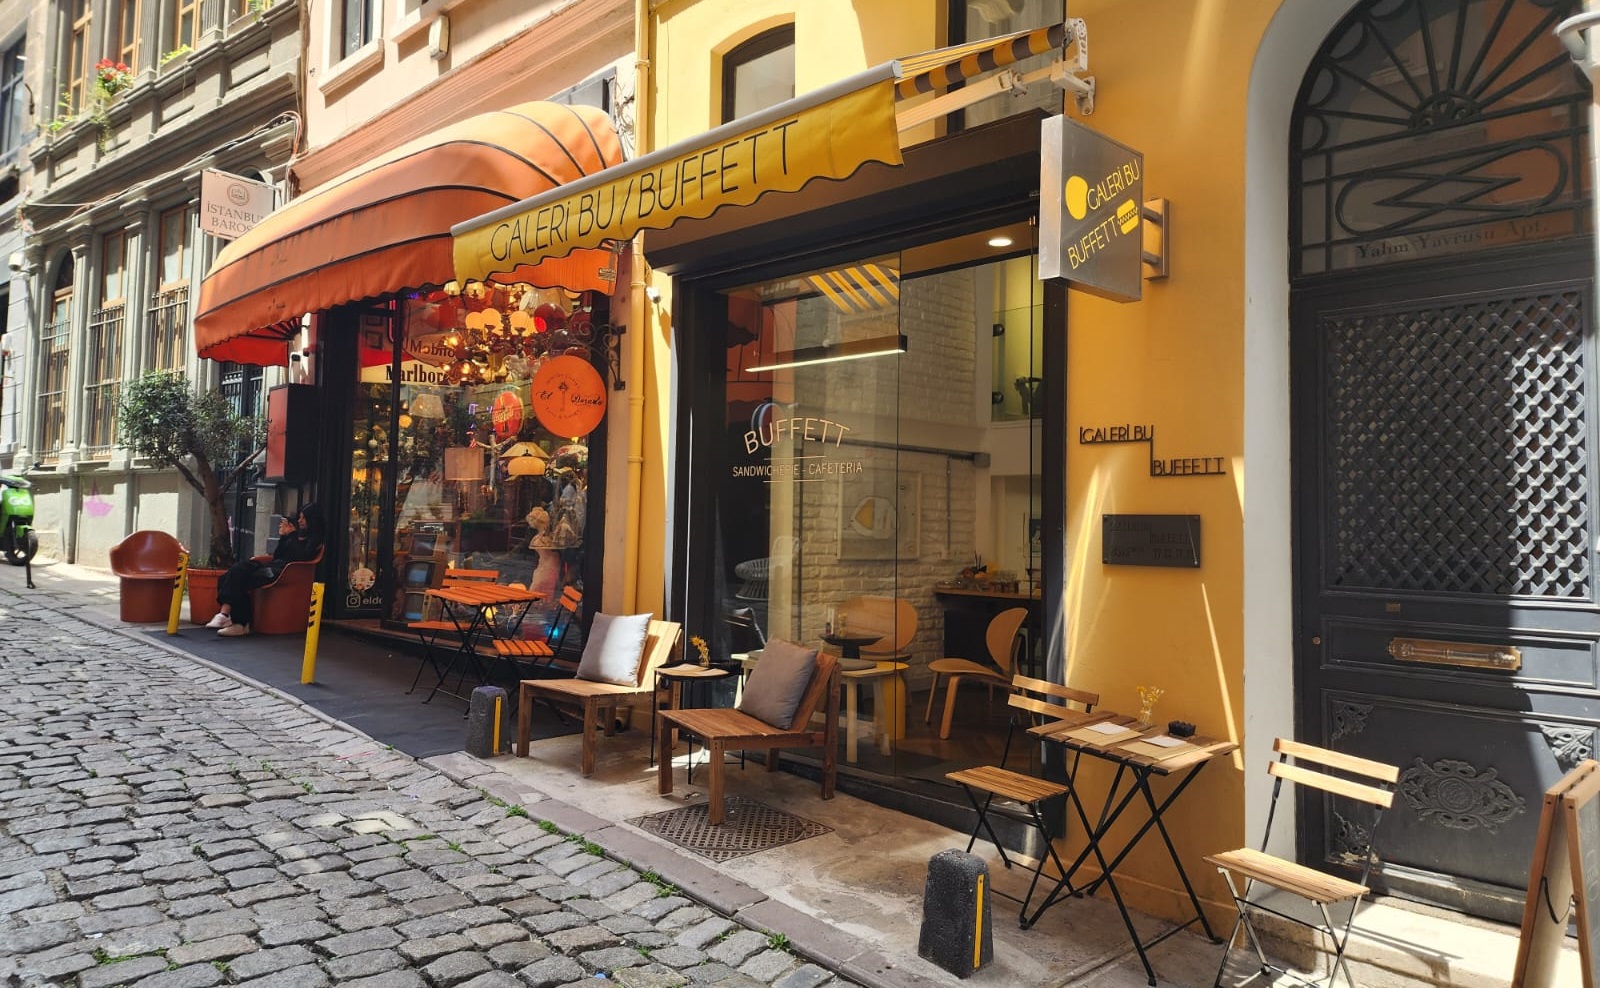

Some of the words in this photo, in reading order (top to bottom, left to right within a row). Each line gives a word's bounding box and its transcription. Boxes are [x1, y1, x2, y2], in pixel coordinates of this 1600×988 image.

[1122, 159, 1140, 186] BU
[207, 201, 263, 223] İSTANBU
[1067, 215, 1118, 270] BUFFETT
[744, 418, 850, 454] BUFFETT
[1133, 424, 1155, 441] BU
[808, 461, 863, 475] CAFETERIA
[1152, 456, 1226, 476] BUFFETT
